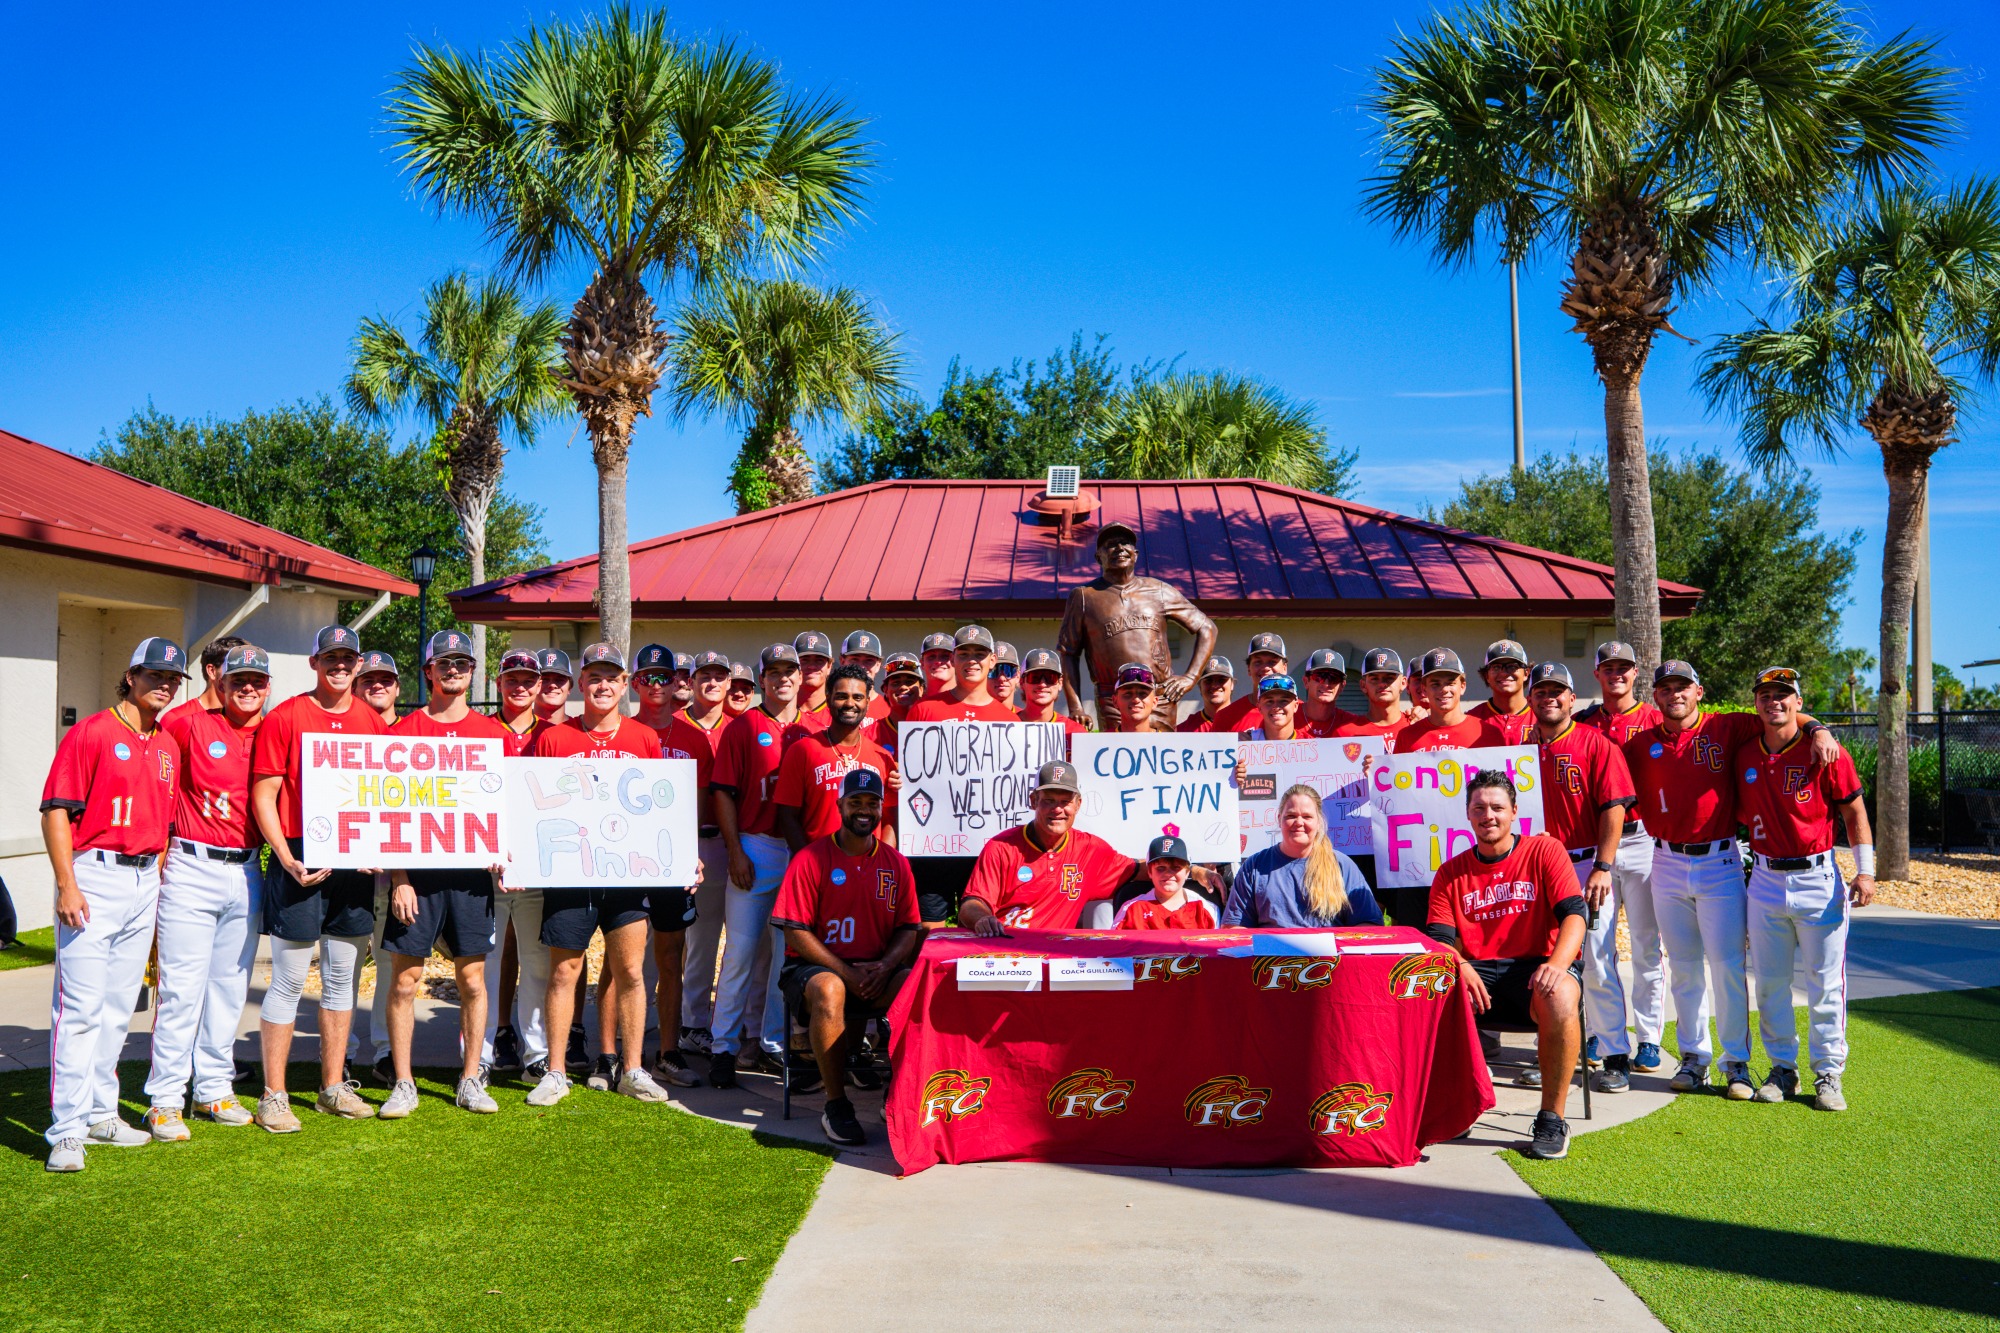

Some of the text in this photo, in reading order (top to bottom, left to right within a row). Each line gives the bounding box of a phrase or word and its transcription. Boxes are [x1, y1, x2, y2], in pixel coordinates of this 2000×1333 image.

[334, 628, 347, 642] F
[448, 634, 460, 648] F
[807, 636, 818, 648] F
[859, 636, 870, 647] F
[934, 635, 943, 645] F
[968, 628, 979, 640] F
[1261, 635, 1272, 647] F
[165, 645, 177, 661] F
[244, 650, 256, 664] F
[370, 654, 382, 667] F
[547, 653, 557, 666] F
[597, 647, 608, 659] F
[651, 649, 661, 662] F
[773, 645, 784, 658] F
[1039, 652, 1049, 665] F
[1325, 652, 1335, 664] F
[1376, 653, 1388, 667] F
[1435, 653, 1445, 666] F
[1543, 663, 1554, 677] F
[313, 740, 487, 773] WELCOME
[903, 723, 1016, 783] CONGRATS
[1093, 745, 1237, 779] CONGRATS
[1238, 740, 1319, 767] ONGRATS
[1692, 735, 1724, 773] FC
[859, 773, 871, 787] F
[1052, 767, 1065, 781] F
[1554, 753, 1582, 796] FC
[1783, 766, 1812, 804] FC
[357, 774, 458, 808] HOME
[948, 773, 1037, 816] WELCOME
[1120, 782, 1222, 821] FINN
[1658, 788, 1669, 814] 1
[111, 796, 134, 827] 11
[200, 789, 232, 821] 14
[1336, 801, 1362, 821] TO
[953, 813, 986, 833] TO
[998, 811, 1030, 831] THE
[1753, 814, 1767, 840] 2
[338, 812, 500, 854] FINN
[536, 818, 672, 879] Finn!
[901, 834, 971, 856] FLAGLER
[1162, 839, 1174, 852] F
[1060, 863, 1083, 900] FC
[1462, 880, 1536, 915] FLAGLER
[1474, 903, 1528, 922] BASEBALL
[824, 917, 855, 944] 20
[1135, 953, 1202, 982] FC
[1261, 962, 1336, 991] FC
[1397, 971, 1456, 999] FC
[922, 1088, 986, 1128] FC
[1056, 1089, 1131, 1118] FC
[1193, 1098, 1267, 1126] FC
[1318, 1103, 1388, 1136] FC
